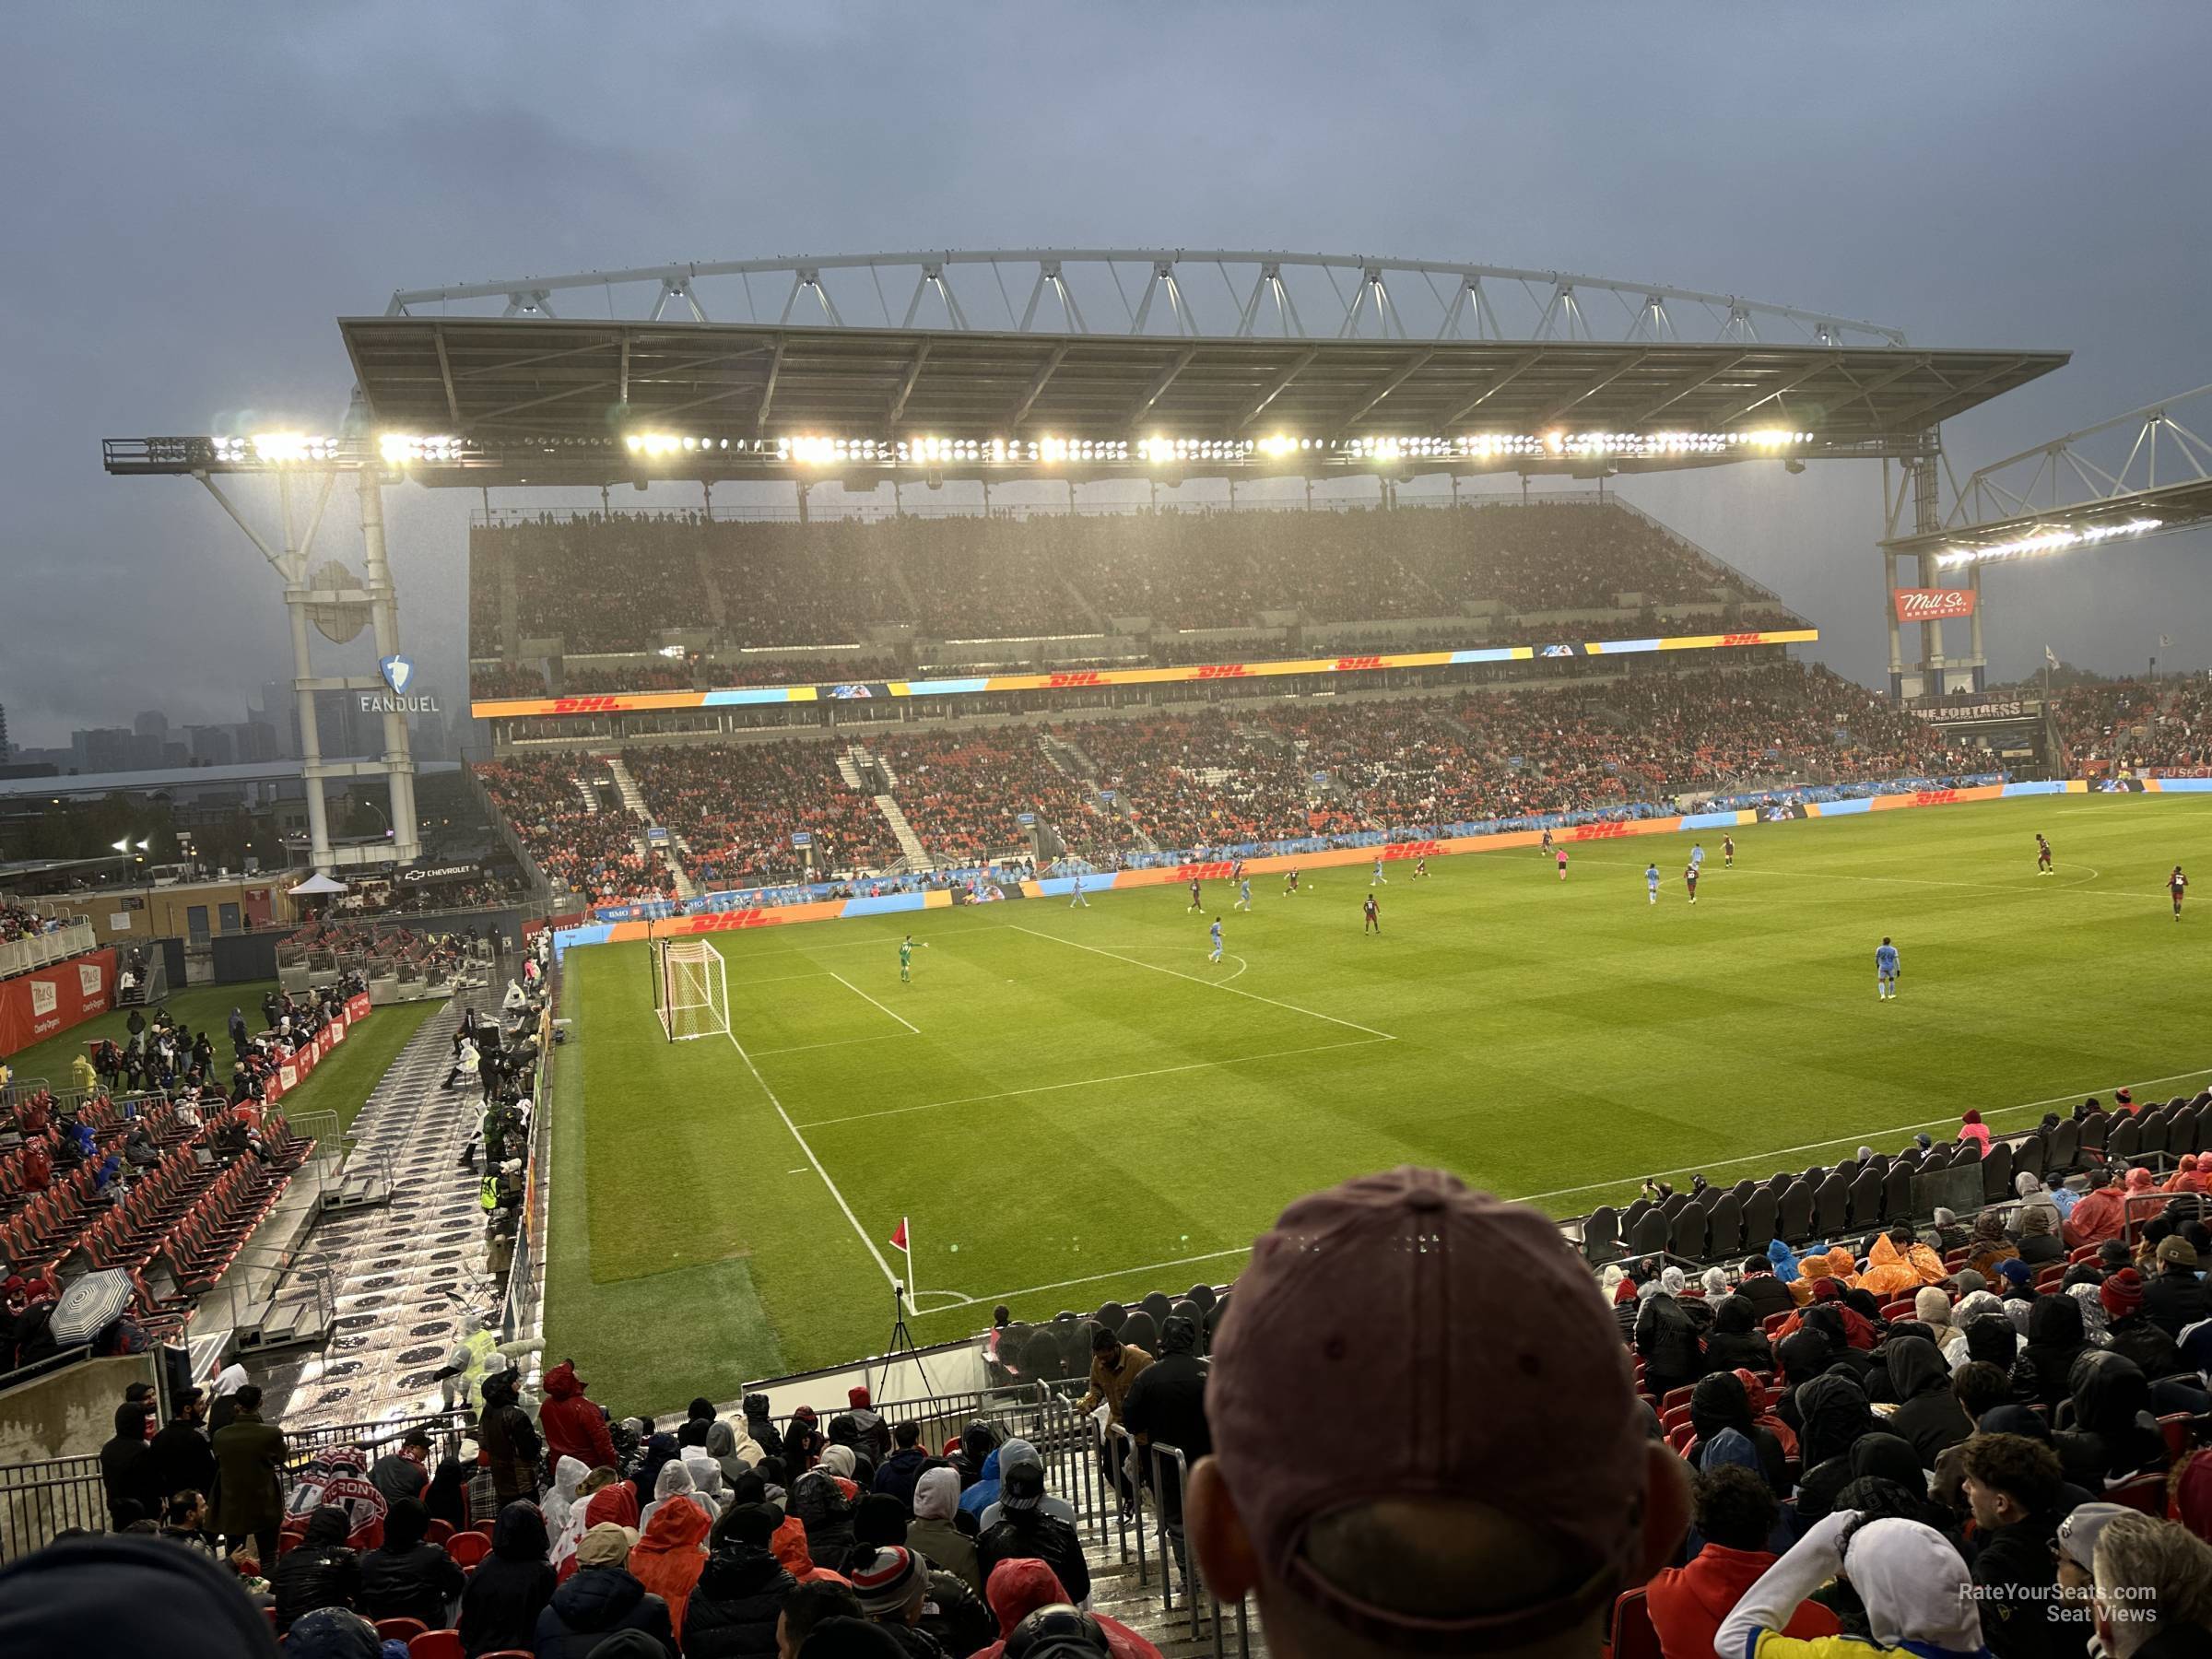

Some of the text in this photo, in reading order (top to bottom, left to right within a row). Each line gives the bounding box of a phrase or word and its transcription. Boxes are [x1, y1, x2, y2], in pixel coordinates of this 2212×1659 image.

[1900, 592, 1967, 611] Mill St.
[1723, 633, 1762, 646] DHL
[1198, 664, 1247, 678] DHL
[1337, 655, 1384, 671] DHL
[1050, 673, 1101, 687] DHL
[360, 696, 440, 712] FANDUEL
[553, 697, 619, 712] DHL
[1939, 701, 2021, 717] FORTRESS
[1916, 789, 1959, 806] DHL
[1574, 821, 1630, 841] DHL
[1383, 840, 1441, 860] DHL
[427, 865, 470, 877] CHEVROLET
[1177, 860, 1233, 882] DHL
[608, 910, 629, 919] BMO
[691, 908, 768, 933] DHL
